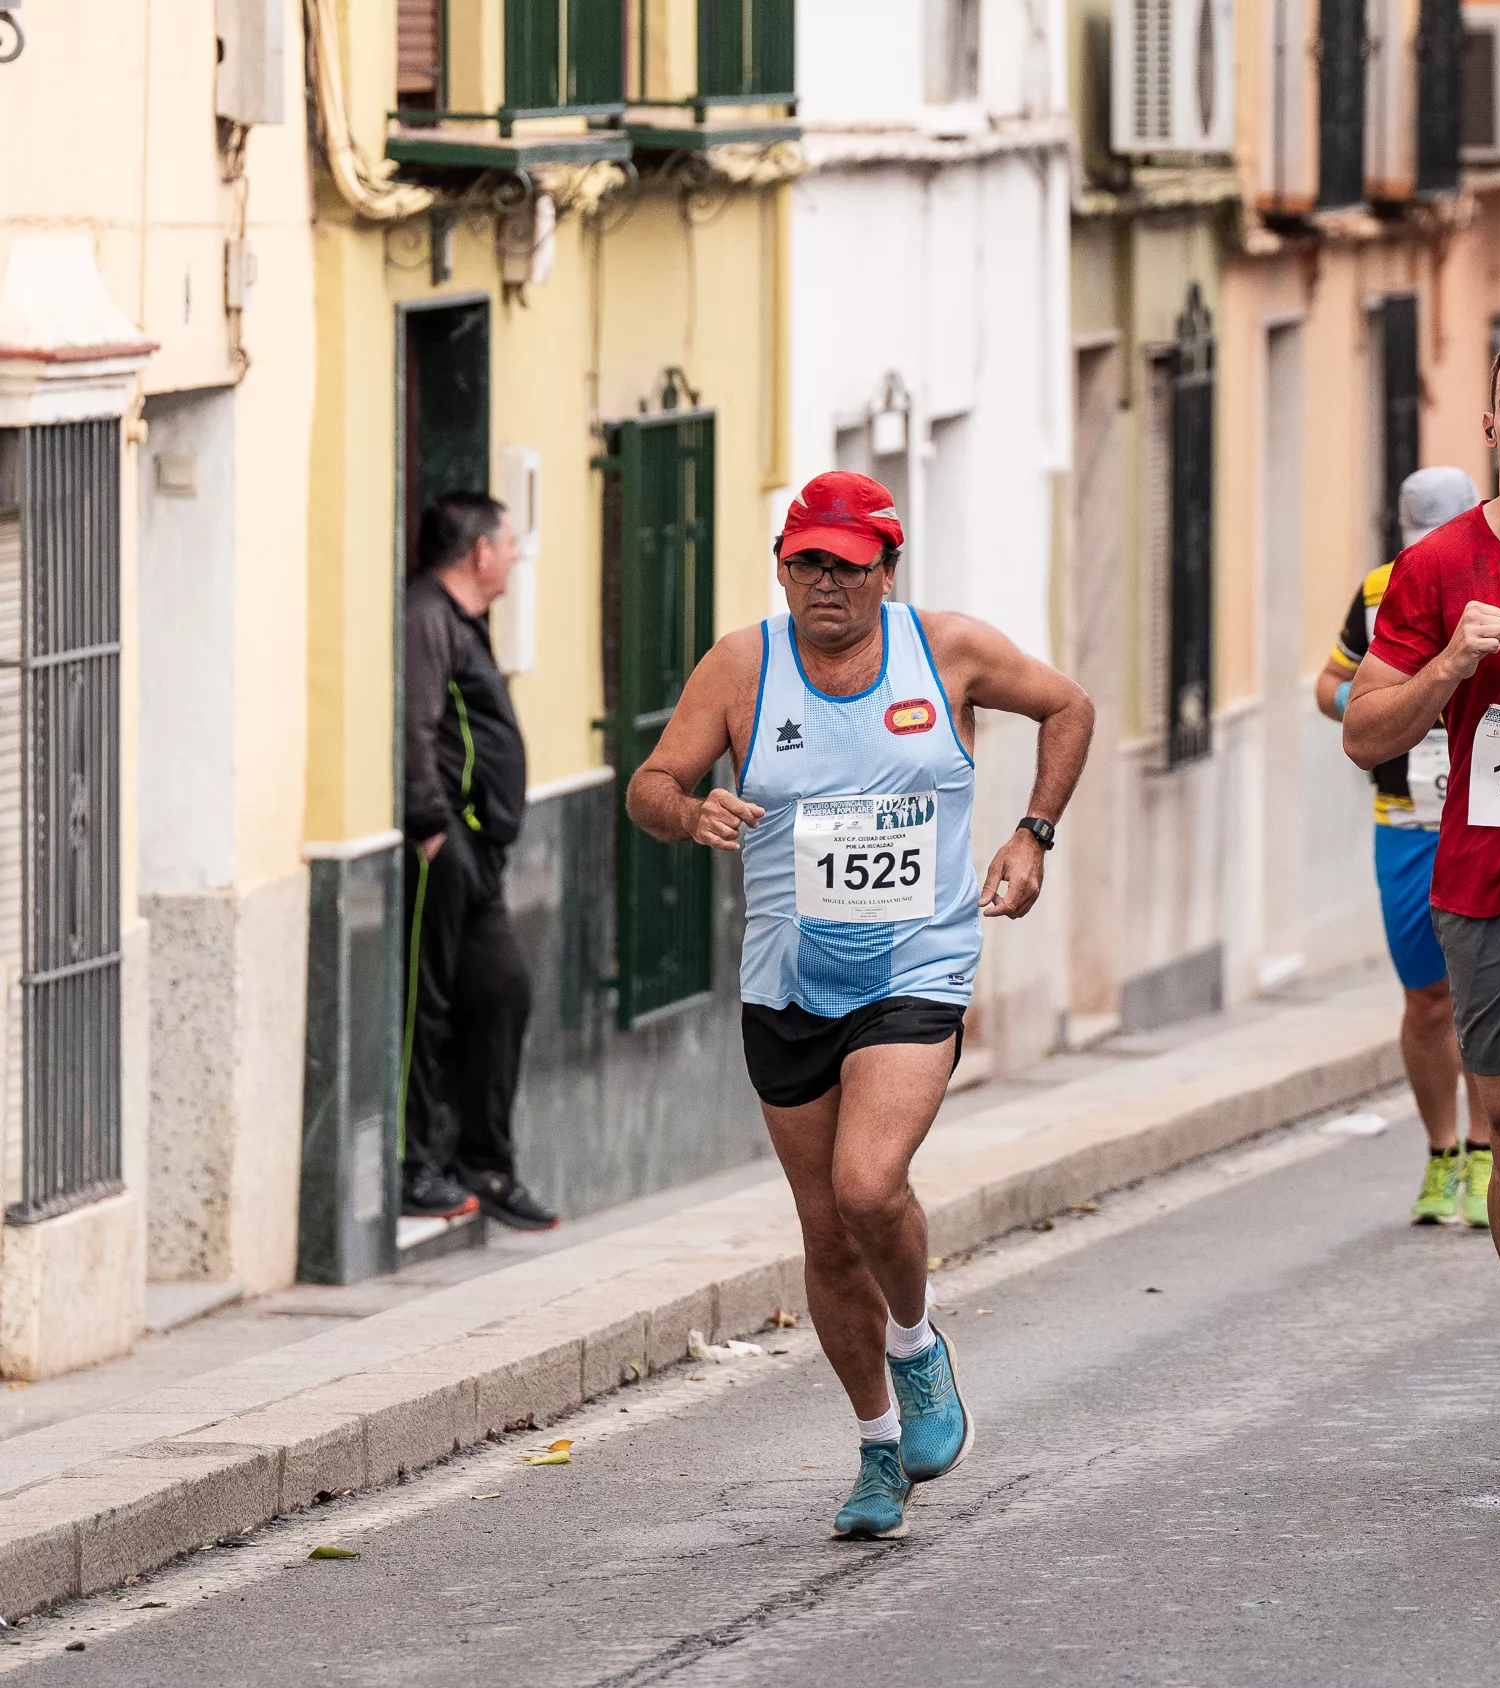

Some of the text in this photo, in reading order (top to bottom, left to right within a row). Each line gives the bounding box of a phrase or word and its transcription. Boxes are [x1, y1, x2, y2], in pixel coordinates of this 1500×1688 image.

[777, 741, 804, 752] luanvi
[803, 802, 829, 810] CIRCUITO
[830, 801, 865, 809] PROVINCIAL
[876, 797, 909, 813] 2024
[836, 806, 874, 815] POPULARES
[817, 848, 921, 890] 1525
[822, 897, 845, 905] MIGUEL
